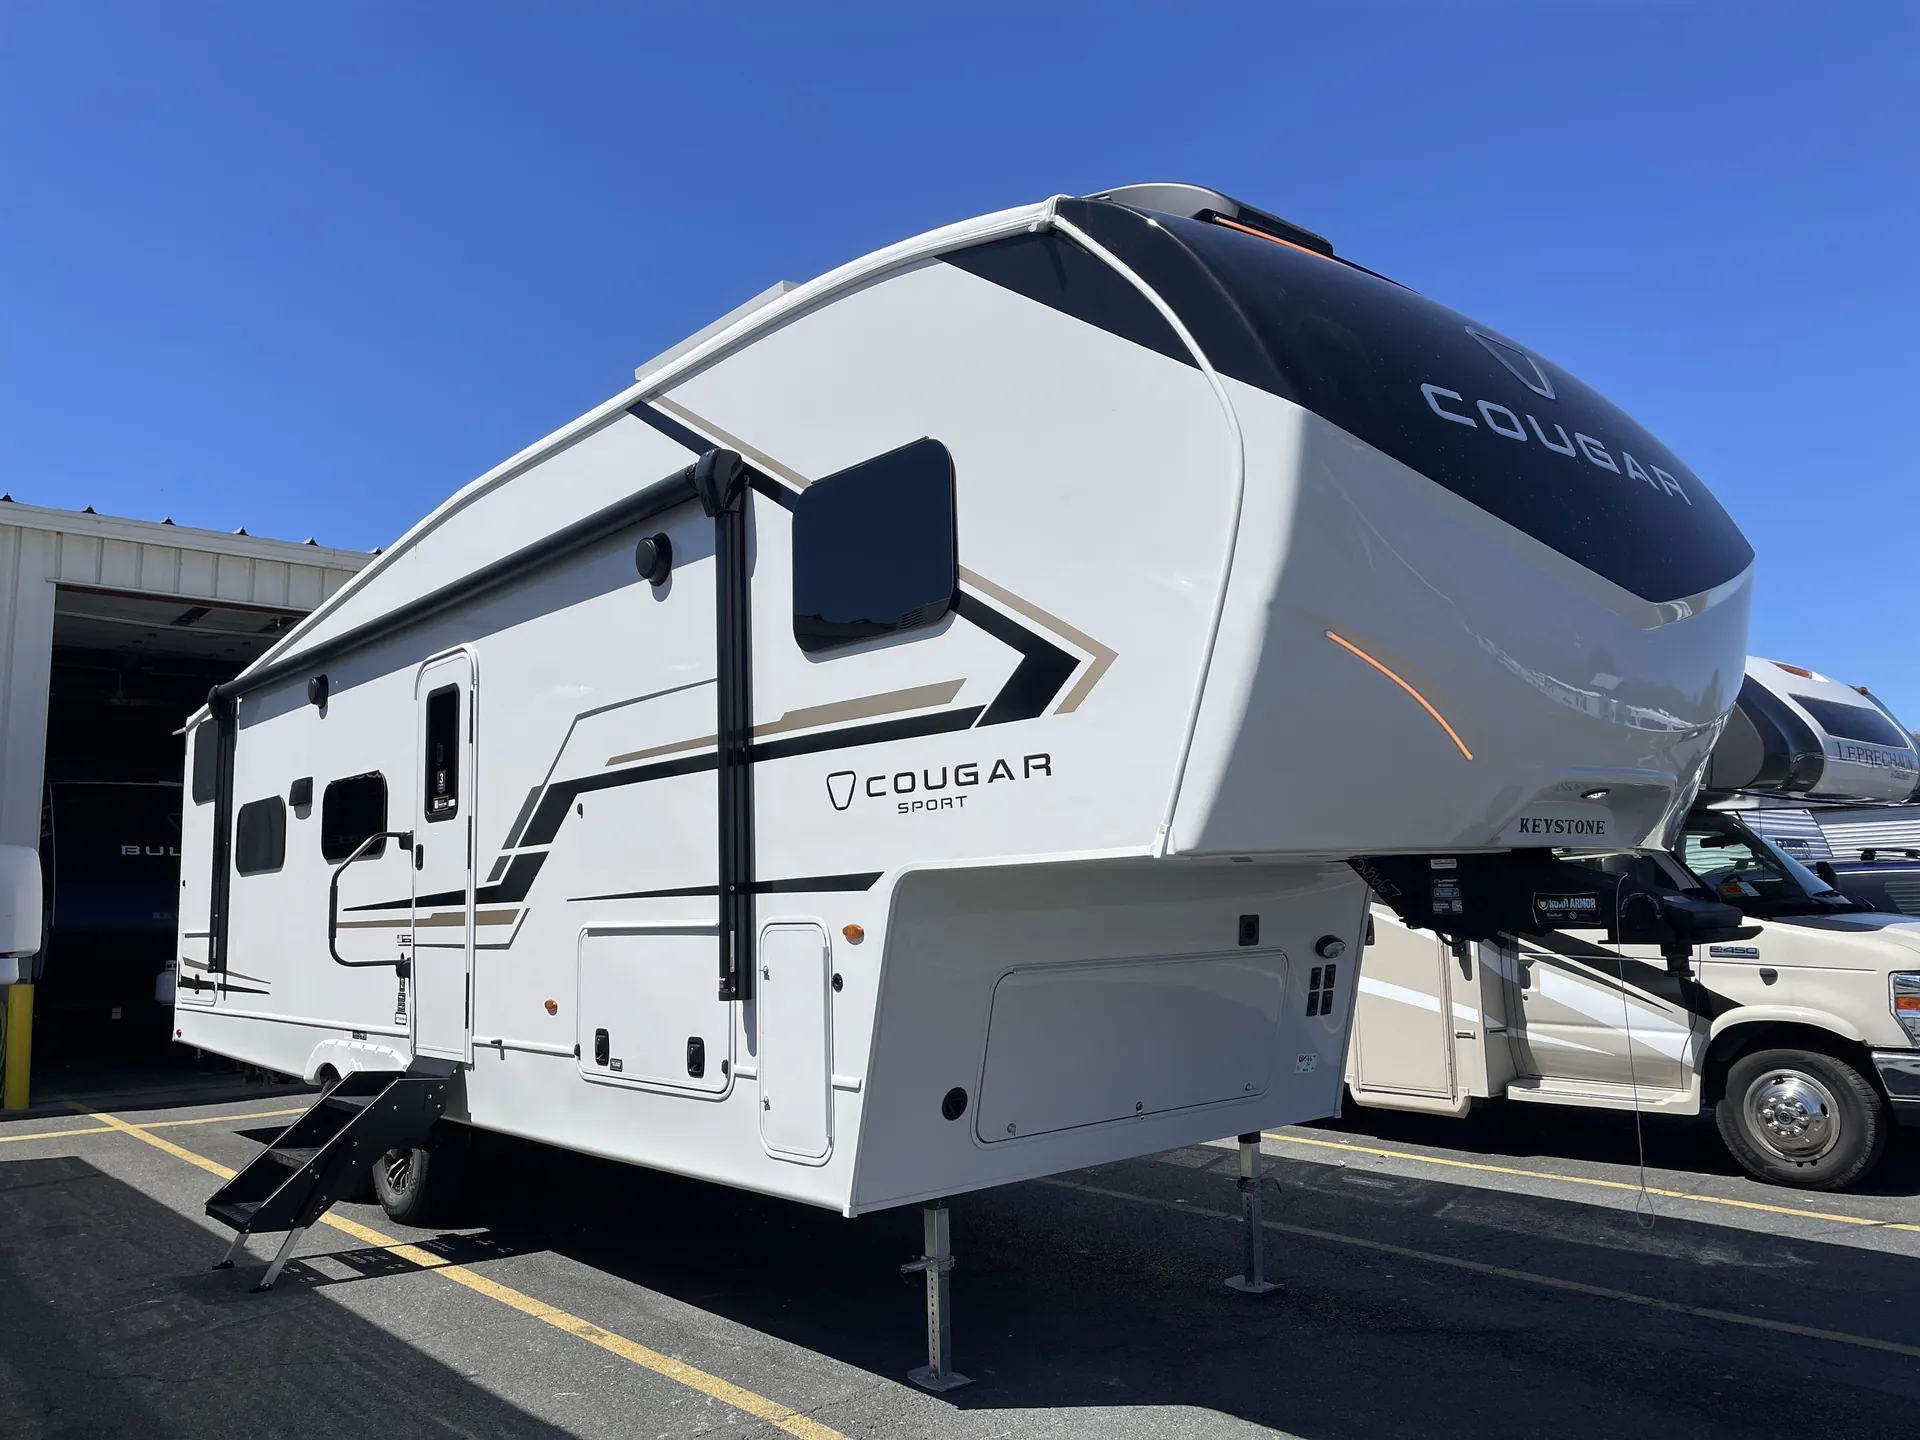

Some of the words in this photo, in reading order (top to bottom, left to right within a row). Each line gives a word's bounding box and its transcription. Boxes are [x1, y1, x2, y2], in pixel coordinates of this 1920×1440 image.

[1420, 383, 1692, 505] COUGAR
[866, 753, 1052, 798] COUGAR
[897, 795, 968, 814] SPORT
[1519, 817, 1606, 835] KEYSTONE
[1570, 897, 1596, 909] ARMOR
